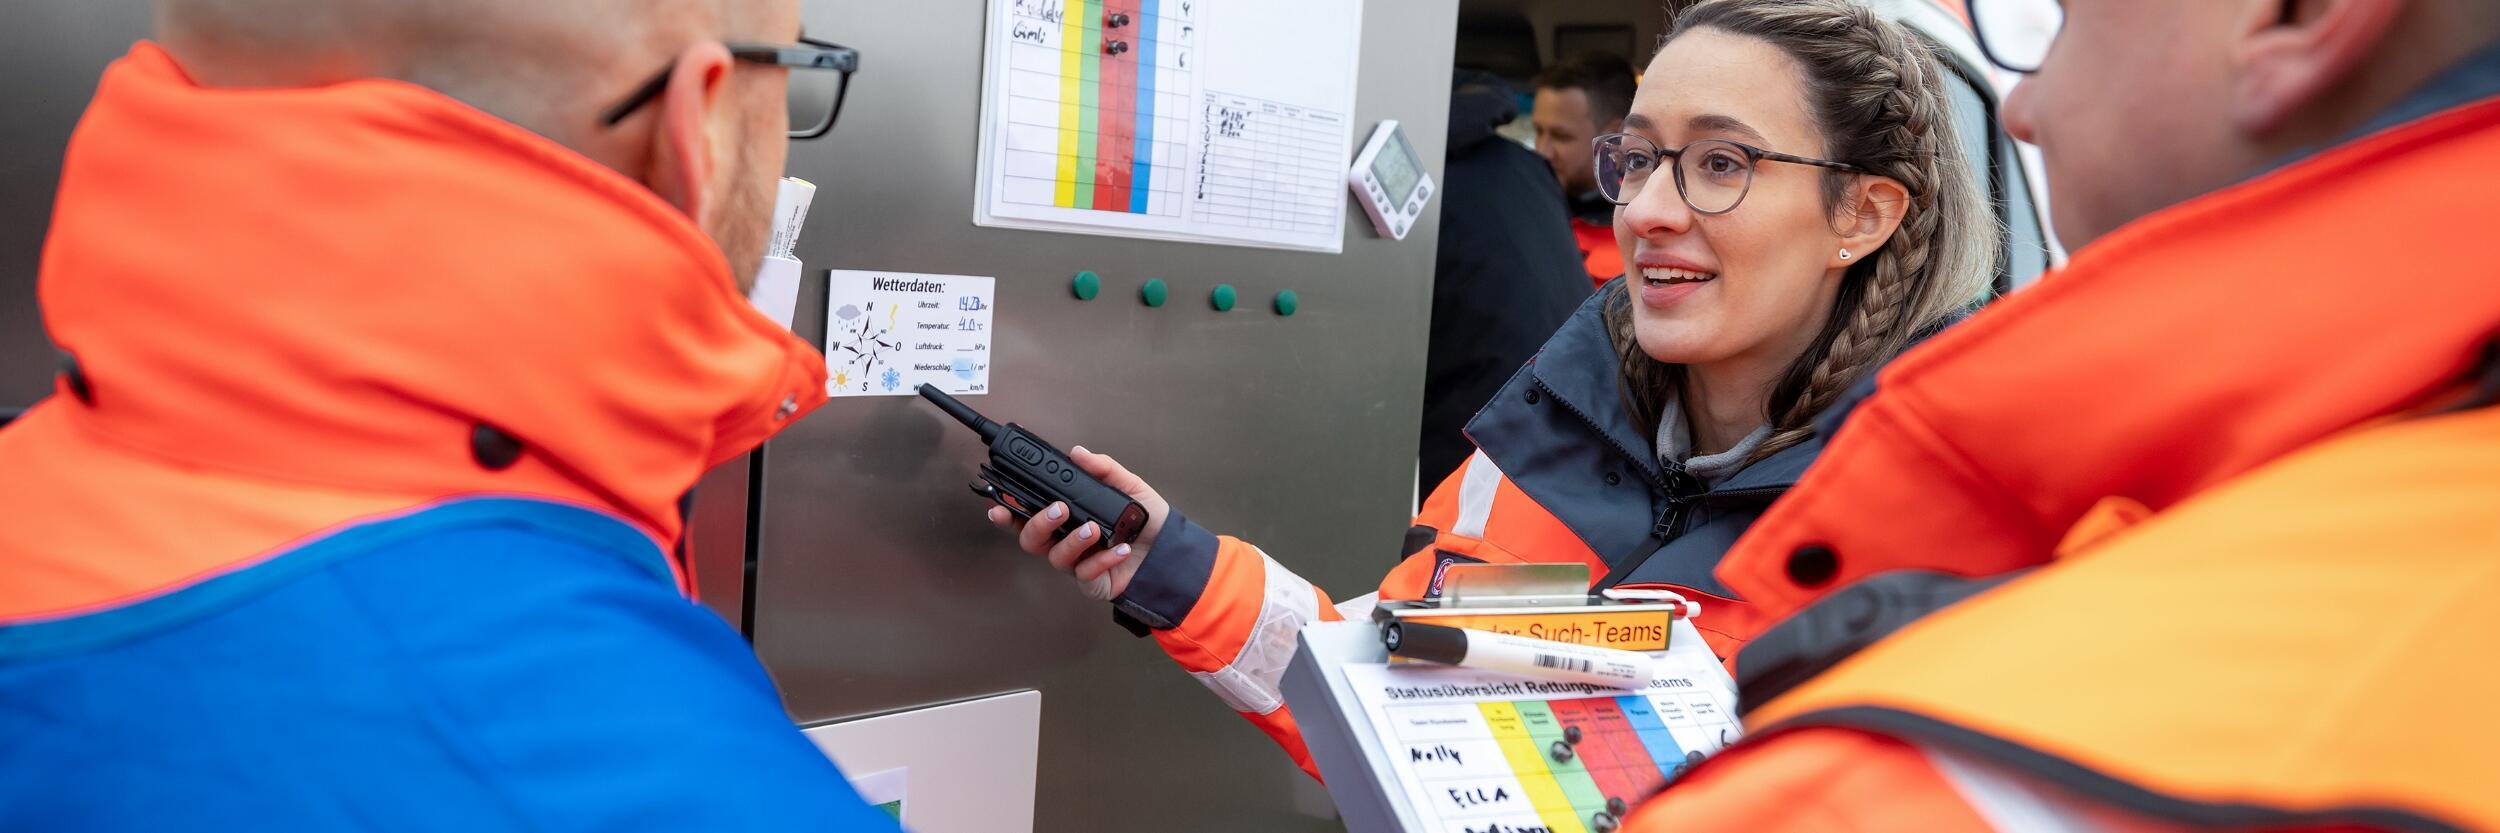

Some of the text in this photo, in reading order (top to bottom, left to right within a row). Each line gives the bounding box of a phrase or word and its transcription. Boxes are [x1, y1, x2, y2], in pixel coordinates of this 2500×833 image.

[1013, 20, 1046, 44] Gimli
[873, 277, 946, 293] Wetterdaten:
[866, 302, 873, 311] N
[918, 301, 940, 309] Uhrzeit:
[917, 322, 949, 331] Temperatur:
[832, 341, 840, 351] W
[914, 363, 952, 371] Niederschlag:
[862, 382, 868, 391] S
[1529, 621, 1663, 644] Such-Teams
[1385, 681, 1523, 699] Statusübersicht
